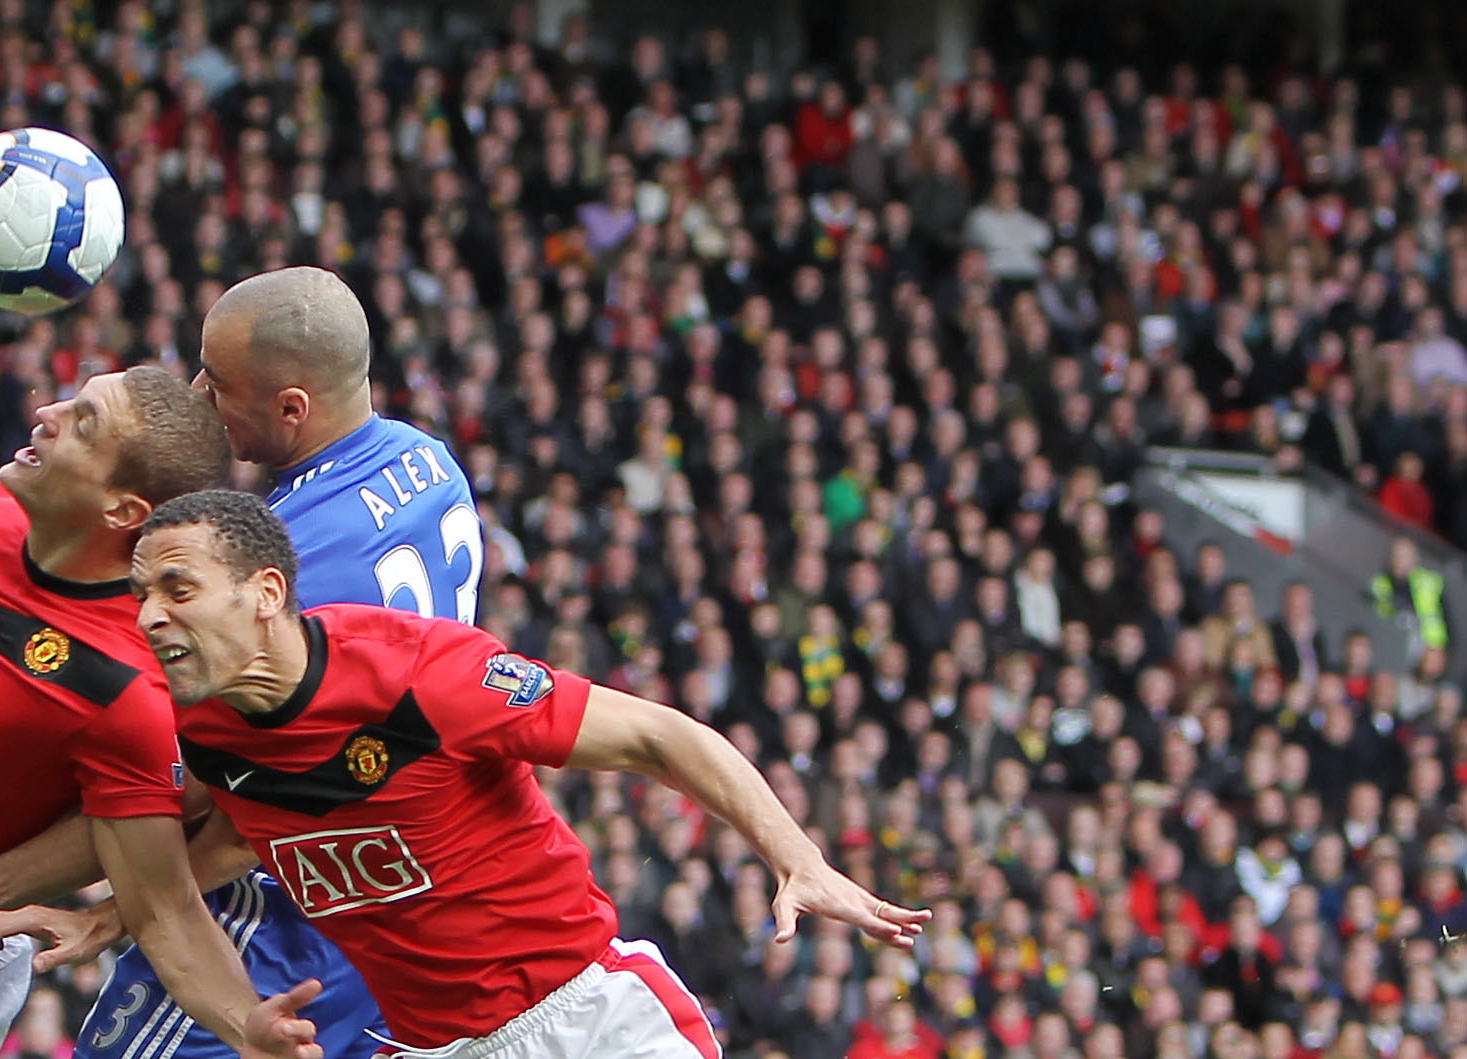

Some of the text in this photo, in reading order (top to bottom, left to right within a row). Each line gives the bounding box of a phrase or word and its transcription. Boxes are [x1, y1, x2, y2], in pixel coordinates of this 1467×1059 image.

[357, 446, 451, 531] ALEX
[292, 837, 414, 908] AIG
[90, 980, 151, 1049] 3
